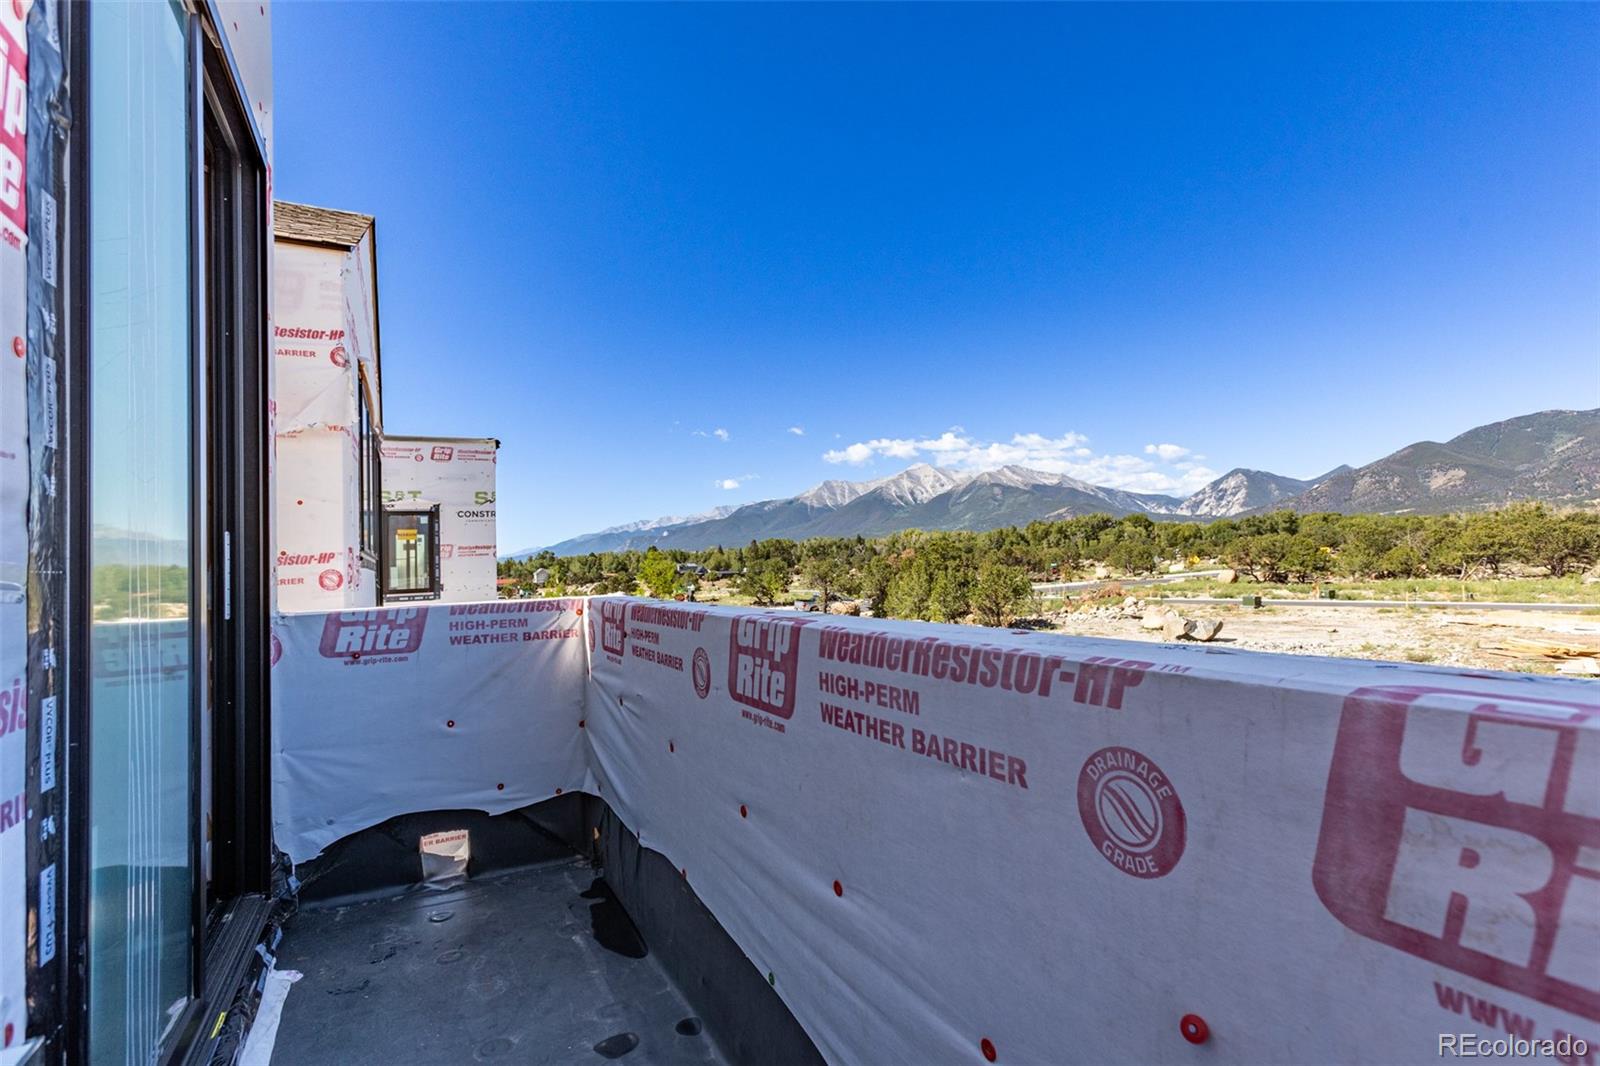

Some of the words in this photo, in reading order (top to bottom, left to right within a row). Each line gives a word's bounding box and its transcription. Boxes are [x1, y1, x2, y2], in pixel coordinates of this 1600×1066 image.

[275, 348, 317, 357] ARRIER
[334, 624, 410, 653] Rite
[450, 618, 528, 632] HIGH-PERM
[450, 633, 518, 646] WEATHER
[523, 618, 579, 642] BARRIER
[737, 615, 793, 662] Grip
[632, 645, 656, 663] WEATHER
[657, 651, 684, 672] BARRIER
[736, 653, 786, 709] Rite
[819, 671, 920, 716] HIGH-PERM
[820, 701, 906, 750] WEATHER
[912, 727, 1029, 789] BARRIER
[1086, 751, 1173, 801] DRAINAGE
[1102, 840, 1159, 874] GRADE
